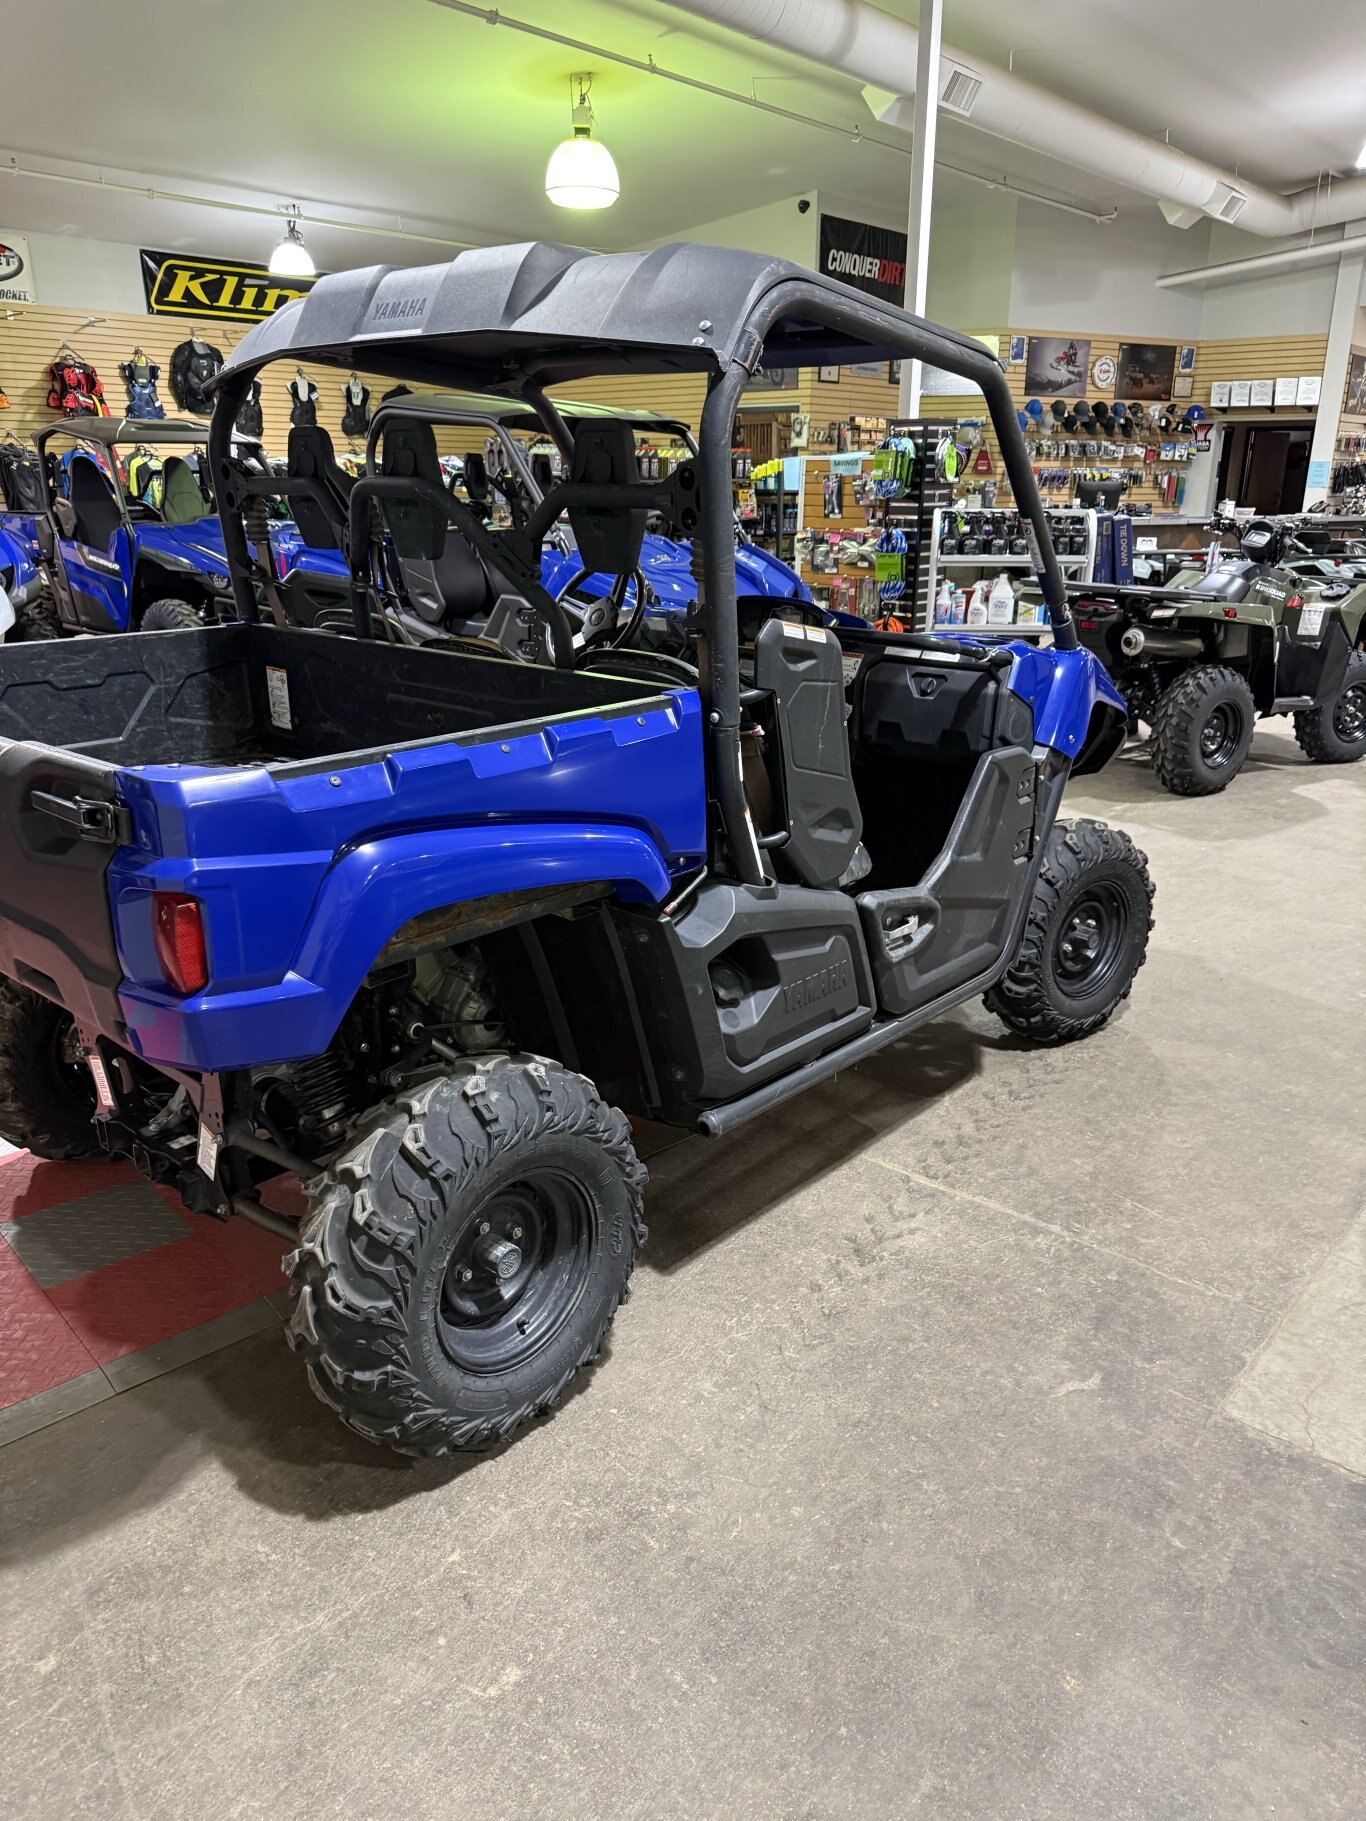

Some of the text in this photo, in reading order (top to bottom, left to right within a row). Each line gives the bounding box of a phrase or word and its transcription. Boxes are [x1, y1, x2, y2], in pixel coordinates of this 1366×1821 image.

[373, 298, 428, 321] YAMAHA
[833, 459, 859, 468] SAVINGS
[1119, 524, 1128, 567] TIE DOWN
[783, 959, 849, 1014] YAMAHA
